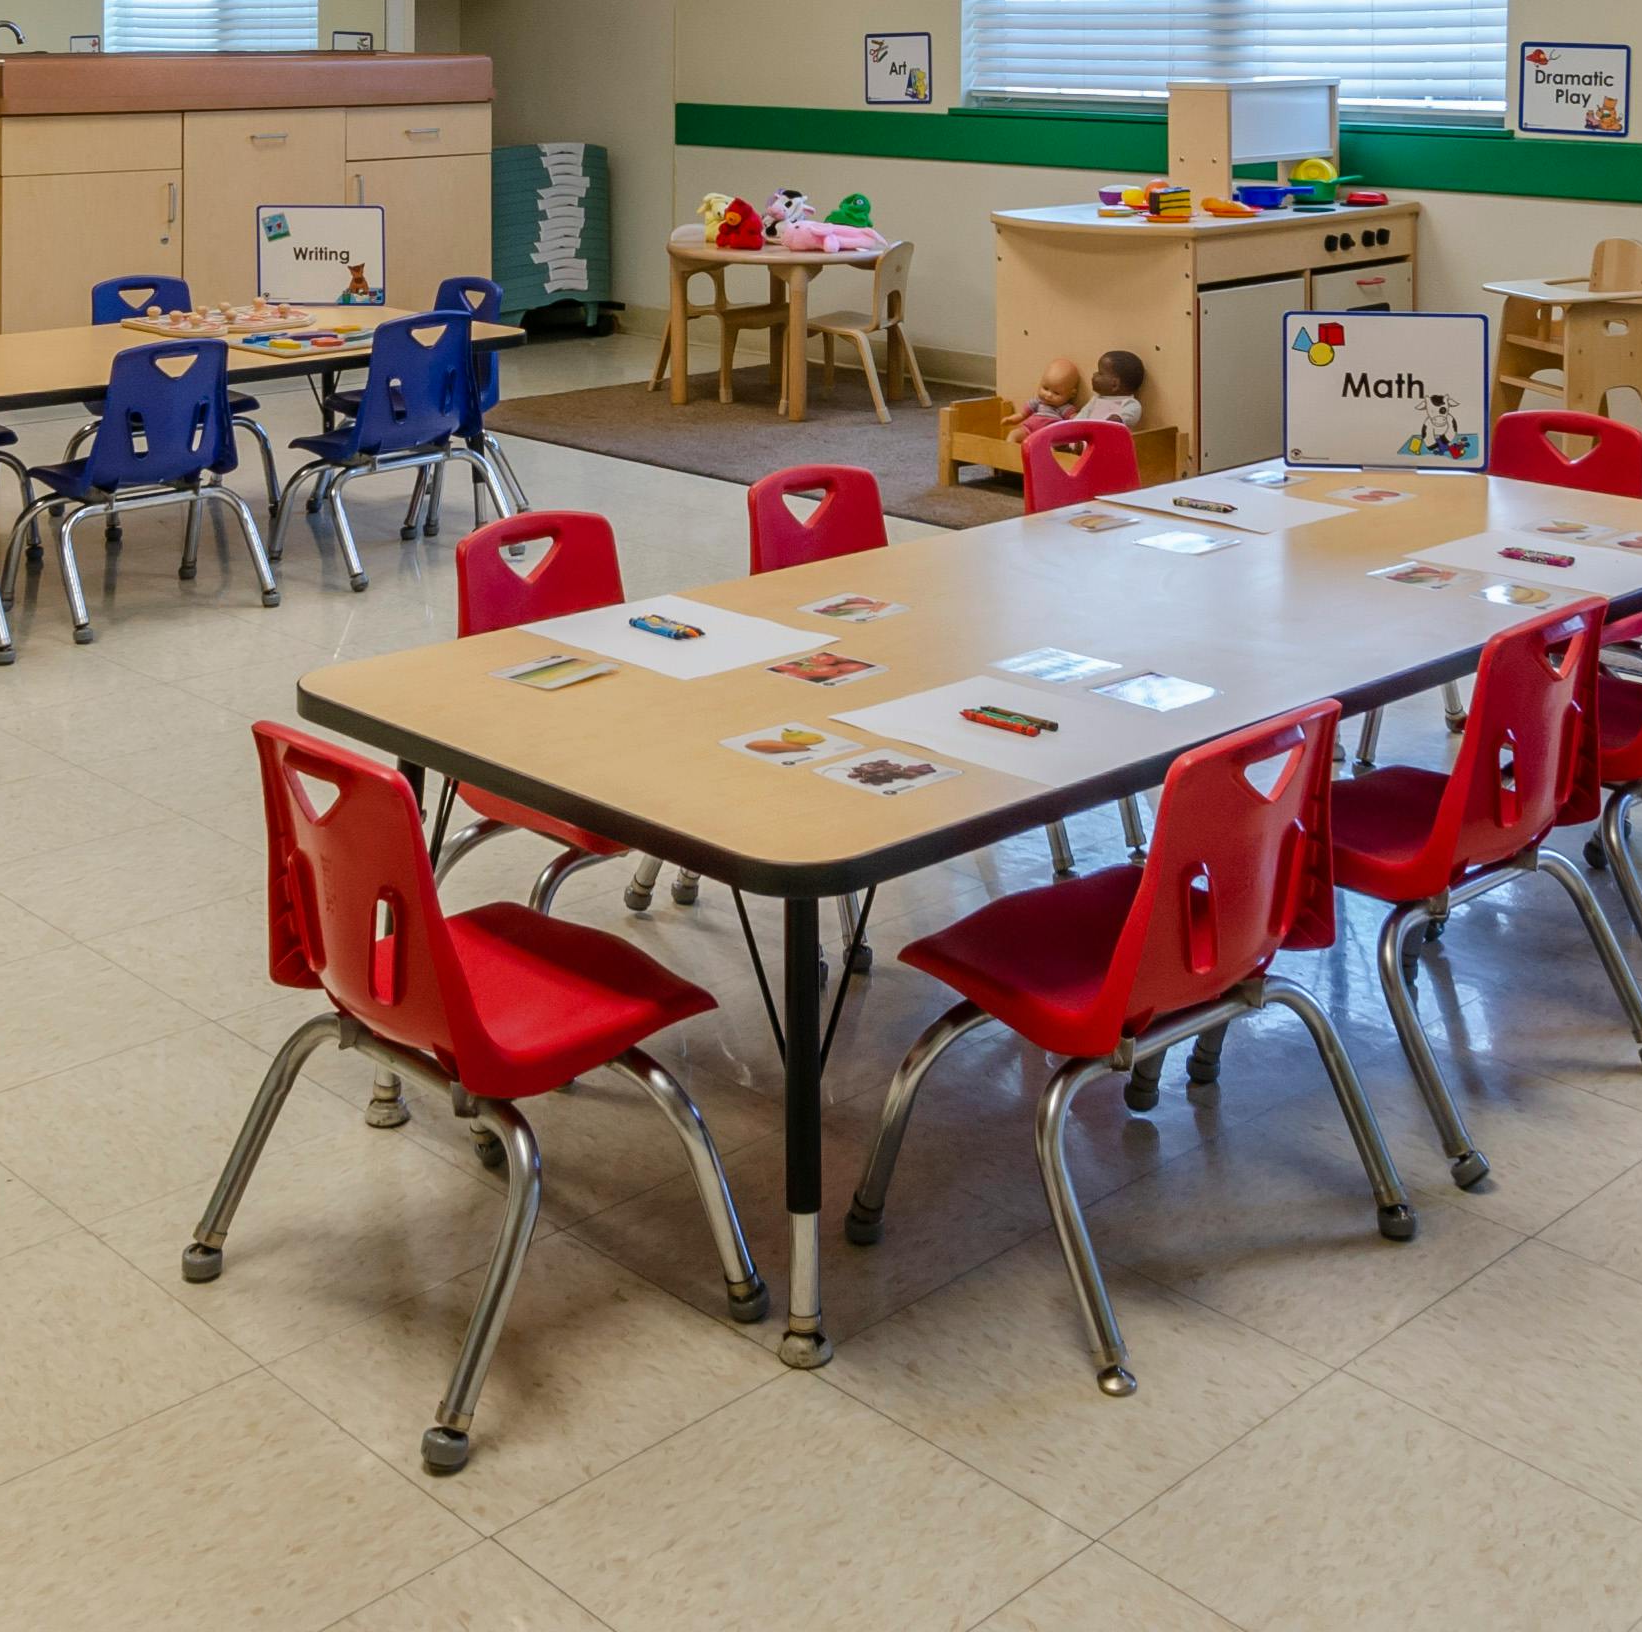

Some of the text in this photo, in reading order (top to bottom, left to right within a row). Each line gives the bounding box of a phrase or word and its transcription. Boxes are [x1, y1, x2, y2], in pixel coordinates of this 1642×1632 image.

[889, 61, 907, 75] Art
[1535, 69, 1614, 87] Dramatic
[1555, 88, 1592, 108] Play
[293, 246, 350, 265] Writing
[1341, 372, 1425, 399] Math
